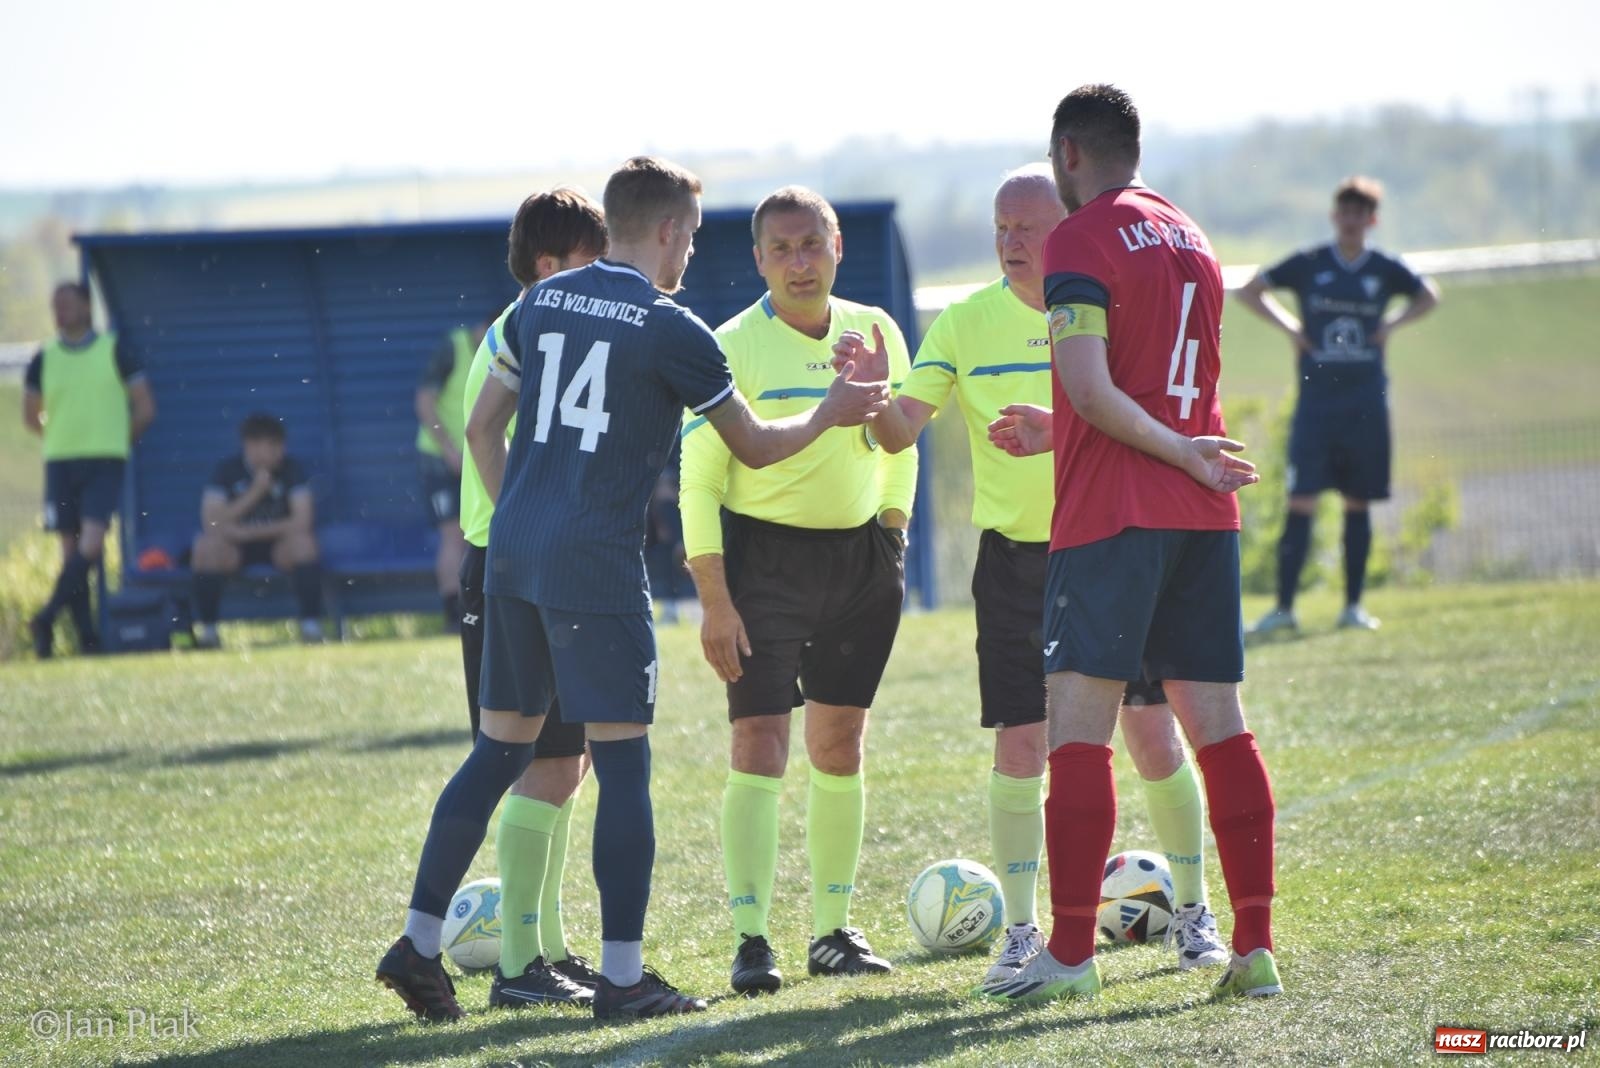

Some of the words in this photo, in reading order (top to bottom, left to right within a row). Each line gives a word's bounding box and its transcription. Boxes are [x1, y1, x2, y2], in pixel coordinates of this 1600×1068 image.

[1118, 220, 1161, 251] LKS
[534, 288, 564, 308] LKS
[562, 292, 649, 327] WOJNOWICE
[1166, 282, 1200, 419] 4
[533, 332, 611, 453] 14
